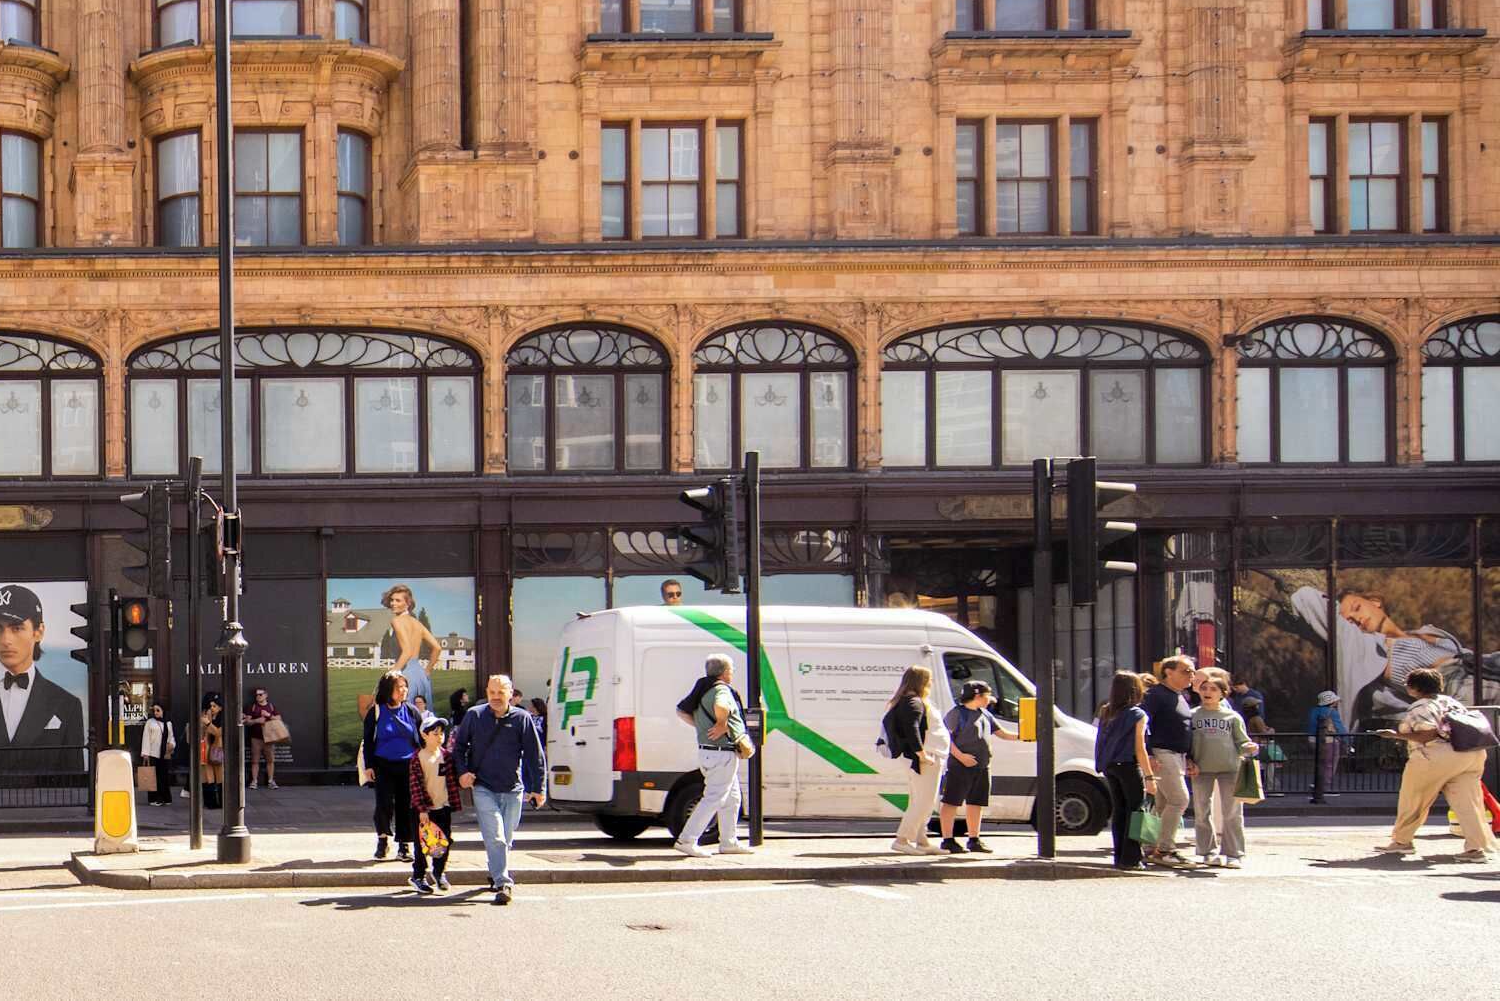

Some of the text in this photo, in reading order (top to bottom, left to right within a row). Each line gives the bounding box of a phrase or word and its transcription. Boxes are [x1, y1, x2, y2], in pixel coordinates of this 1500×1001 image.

[246, 662, 309, 674] LAUREN
[815, 664, 905, 673] PARAGON LOGISTICS
